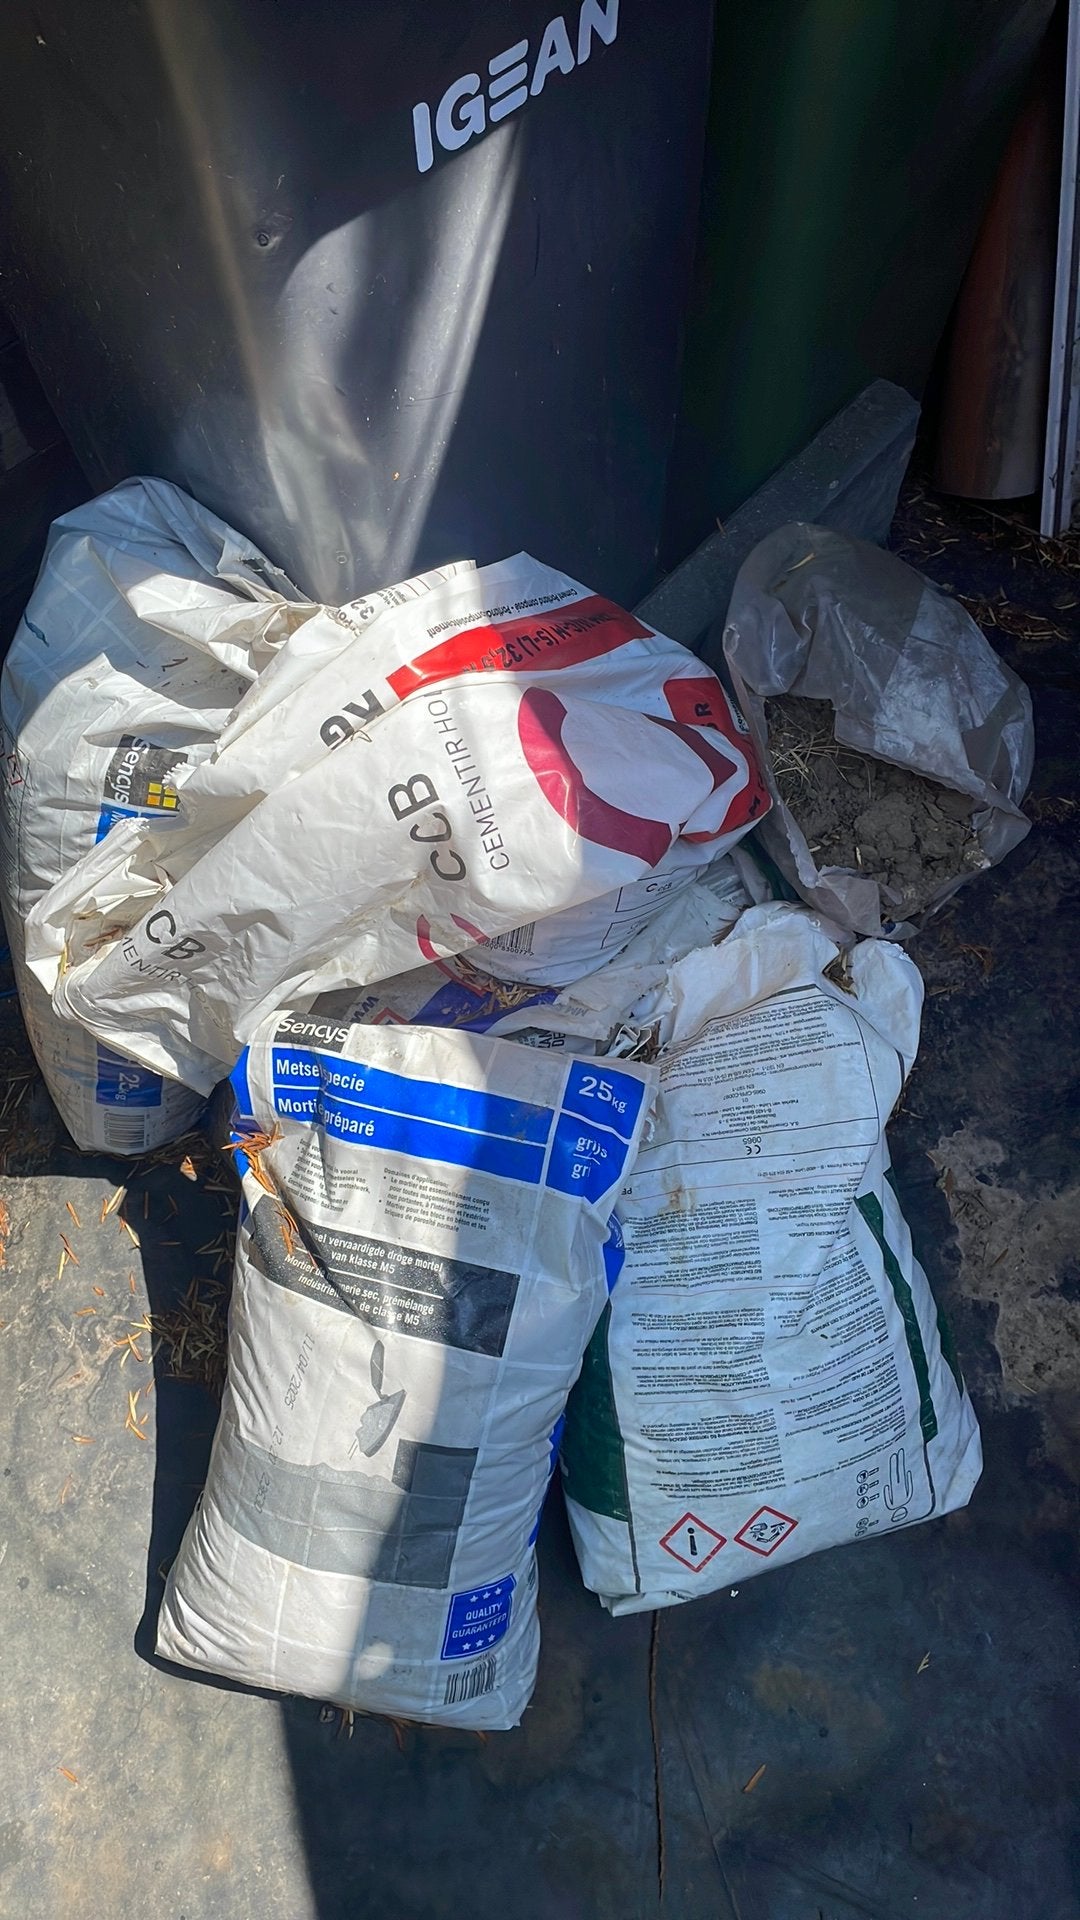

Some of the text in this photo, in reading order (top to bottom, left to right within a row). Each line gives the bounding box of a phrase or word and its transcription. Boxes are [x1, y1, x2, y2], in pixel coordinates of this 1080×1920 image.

[413, 0, 619, 172] IGEAN
[107, 736, 151, 804] Sencys
[445, 738, 510, 870] CEMENTIR
[388, 773, 466, 881] CCB
[277, 1018, 349, 1043] Sencys
[324, 1110, 374, 1137] préparé
[383, 1167, 410, 1178] Domaines
[388, 1184, 401, 1193] pour
[402, 1188, 419, 1197] toutes
[419, 1192, 455, 1206] maçonneries
[455, 1201, 481, 1213] portantes
[398, 1178, 418, 1188] mortier
[471, 1197, 489, 1207] conçu
[384, 1208, 403, 1218] briques
[412, 1215, 436, 1227] porosité
[436, 1221, 459, 1232] normale
[385, 1200, 405, 1210] Mortier
[405, 1206, 419, 1214] pour
[429, 1211, 445, 1220] blocs
[454, 1217, 470, 1226] béton
[328, 1234, 385, 1260] vervaardigde
[386, 1250, 413, 1266] droge
[414, 1256, 443, 1272] mortel
[330, 1250, 396, 1274] van klasse M5
[358, 1301, 371, 1312] de
[403, 1312, 420, 1326] M5
[361, 1287, 381, 1301] sec,
[382, 1290, 435, 1316] prémélangé
[466, 1602, 502, 1620] QUALITY
[452, 1612, 507, 1639] GUARANTEED
